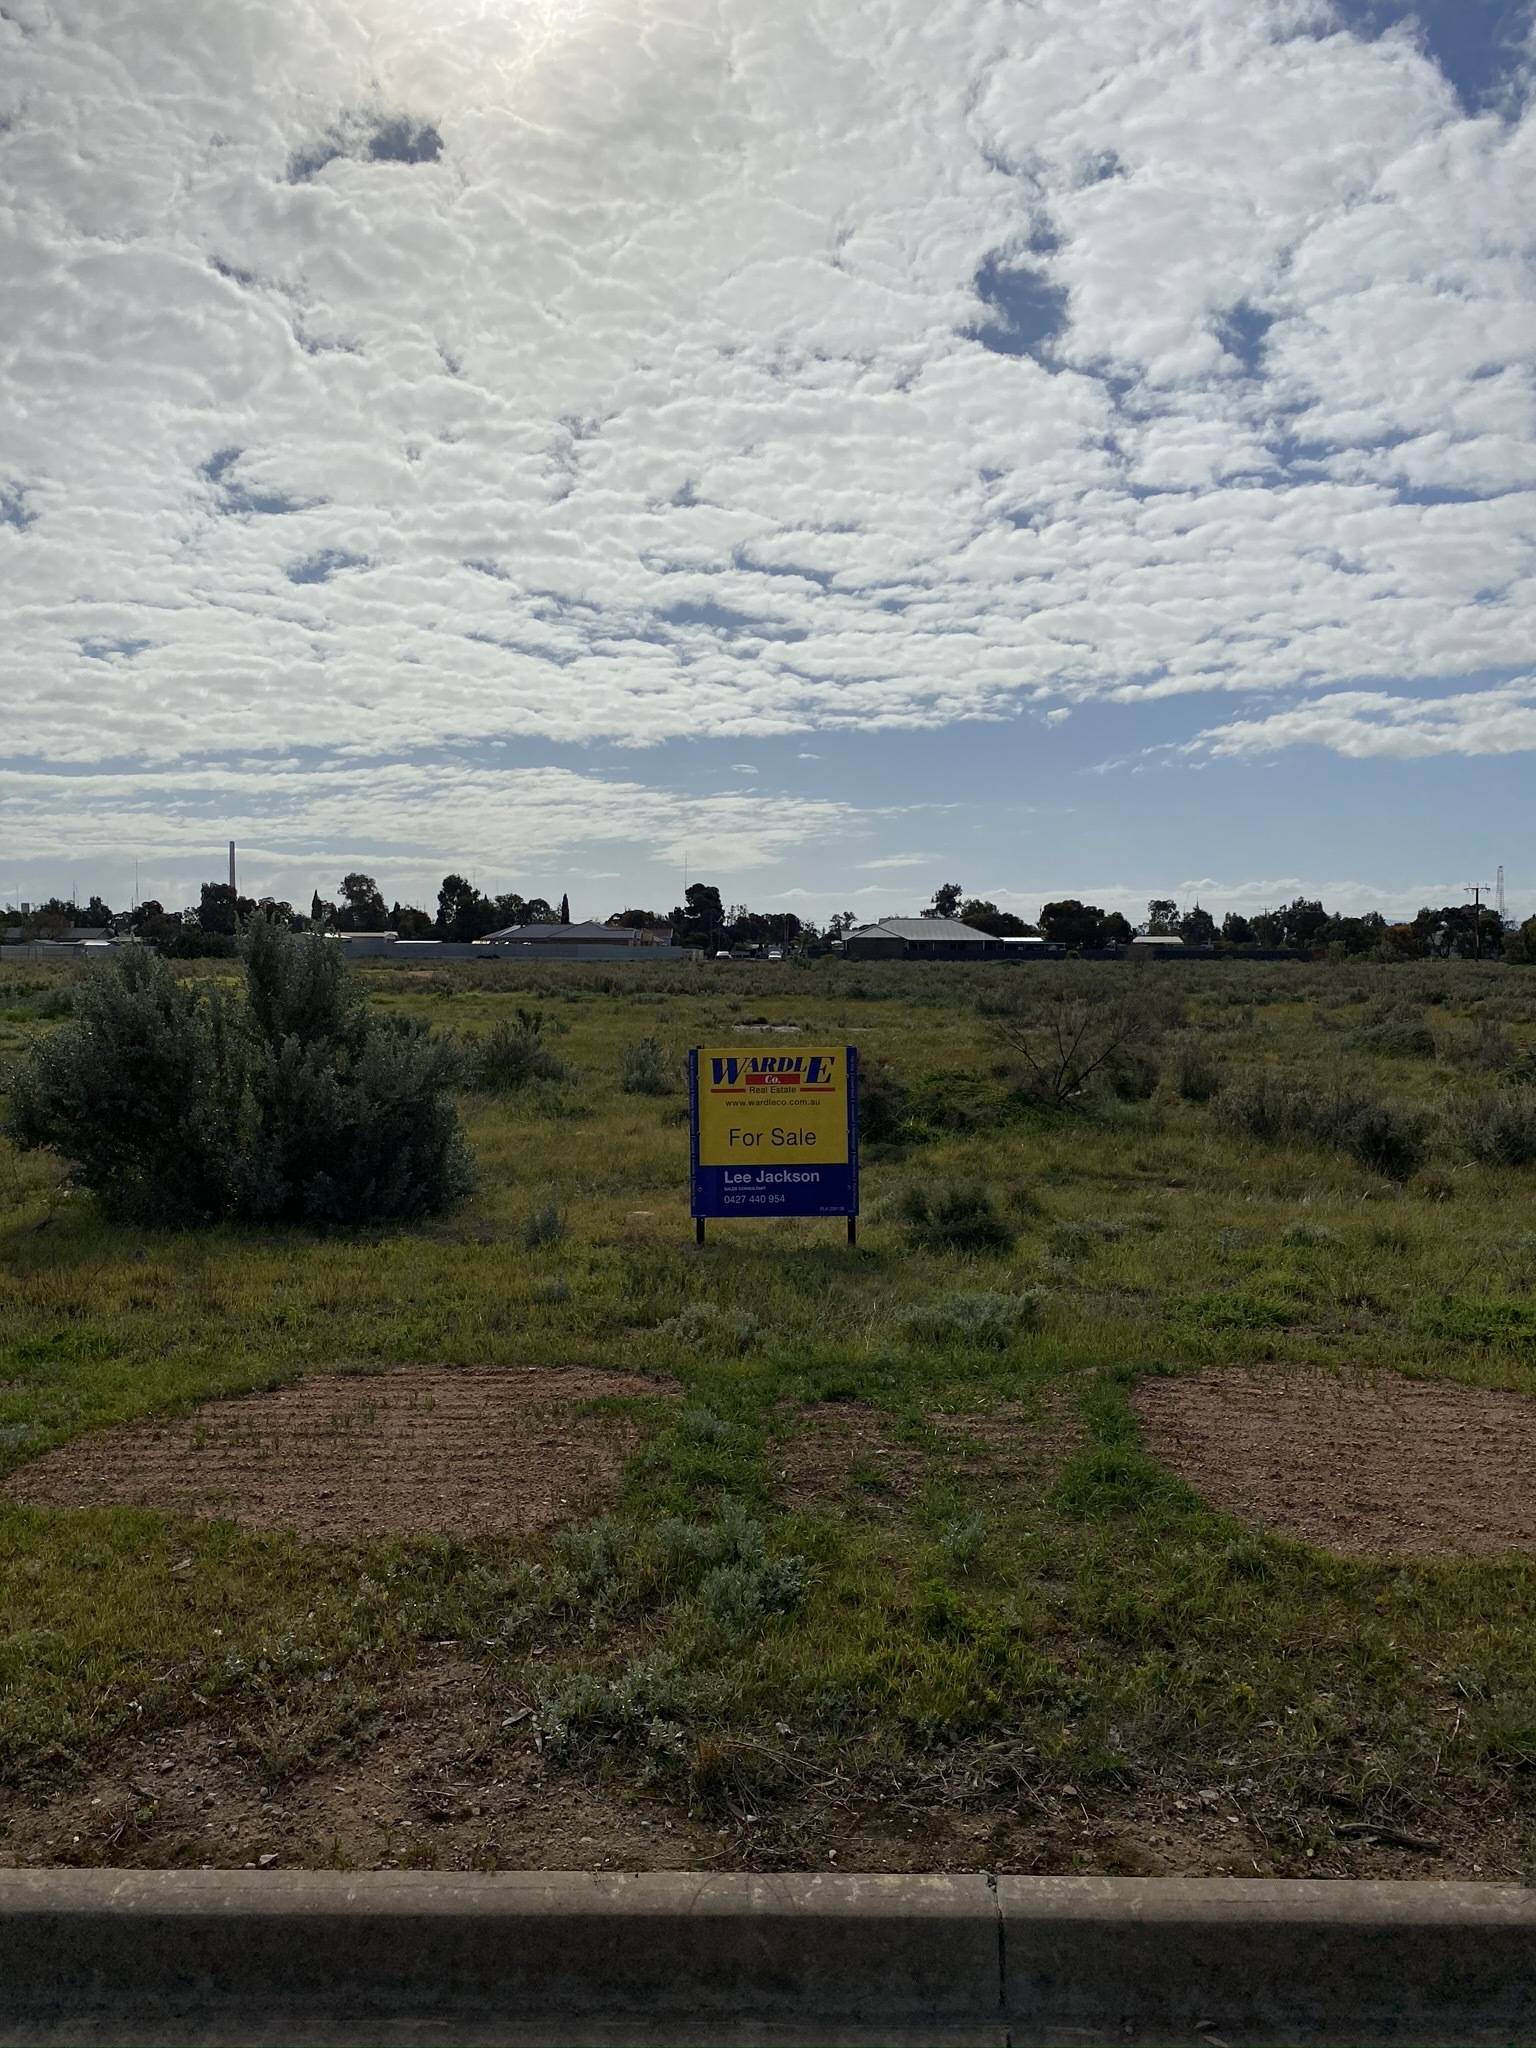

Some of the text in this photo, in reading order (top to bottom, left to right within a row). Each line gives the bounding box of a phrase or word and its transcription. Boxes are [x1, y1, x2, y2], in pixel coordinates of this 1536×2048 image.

[711, 1056, 836, 1085] WARDLE
[764, 1074, 782, 1084] Co.
[749, 1085, 797, 1094] Real Estate
[725, 1098, 821, 1107] www.wardleco.com.au
[729, 1128, 817, 1147] For Sale
[724, 1169, 820, 1184] Lee Jackson
[724, 1194, 785, 1204] 0427 440 954
